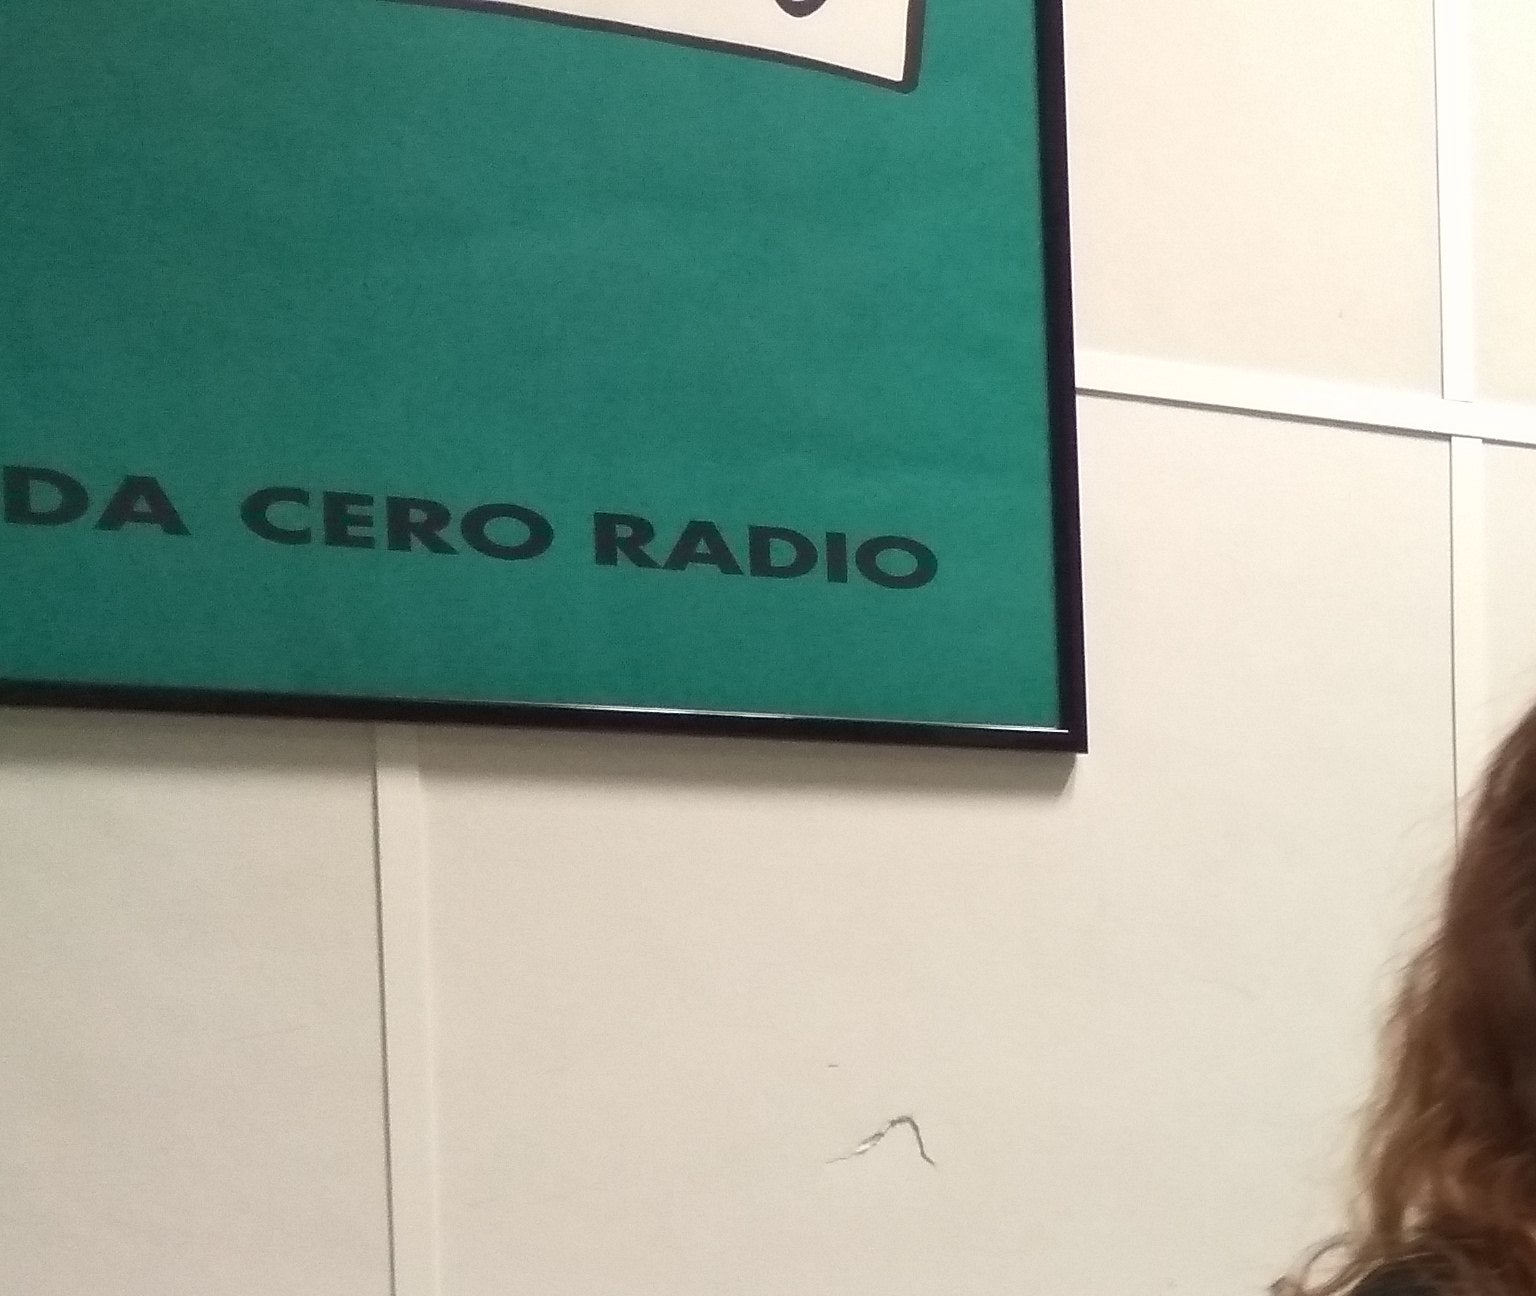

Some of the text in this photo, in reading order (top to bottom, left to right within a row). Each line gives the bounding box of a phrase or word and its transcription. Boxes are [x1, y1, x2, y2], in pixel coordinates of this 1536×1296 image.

[3, 466, 938, 590] DA CERO RADIO
